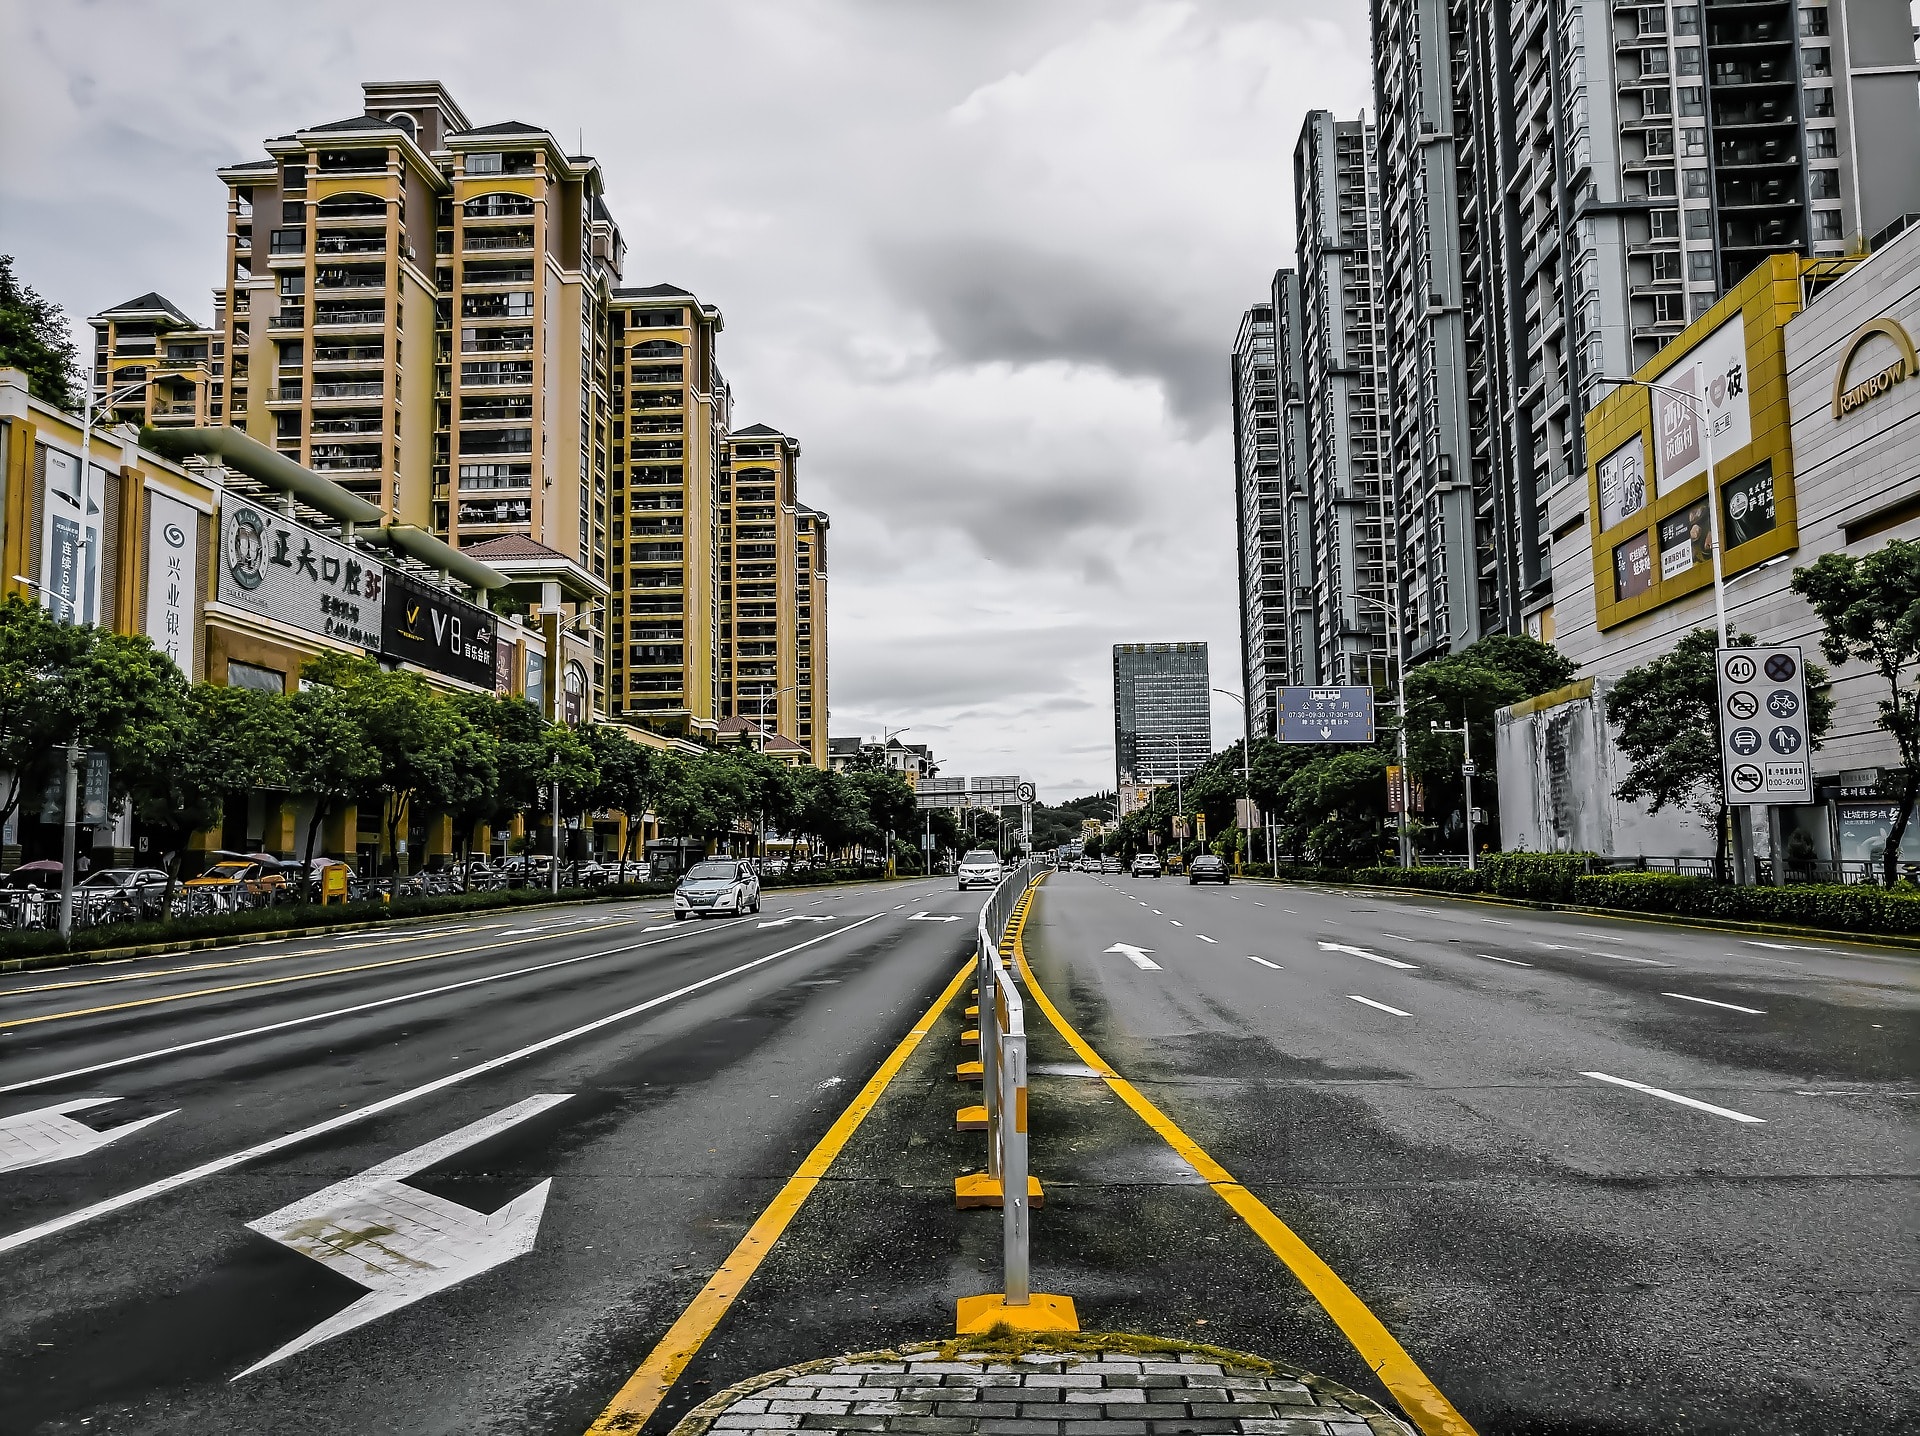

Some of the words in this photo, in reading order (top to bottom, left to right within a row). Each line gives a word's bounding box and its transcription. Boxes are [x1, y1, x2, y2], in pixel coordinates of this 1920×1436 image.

[1840, 360, 1904, 414] RAINBOW
[364, 569, 382, 602] 3F
[164, 555, 181, 663] 兴业银行
[430, 608, 462, 656] V8
[464, 642, 490, 665] 音乐会所
[1731, 662, 1750, 677] 40
[1302, 701, 1350, 710] 公交专用
[1768, 778, 1804, 786] 0:00-24:00
